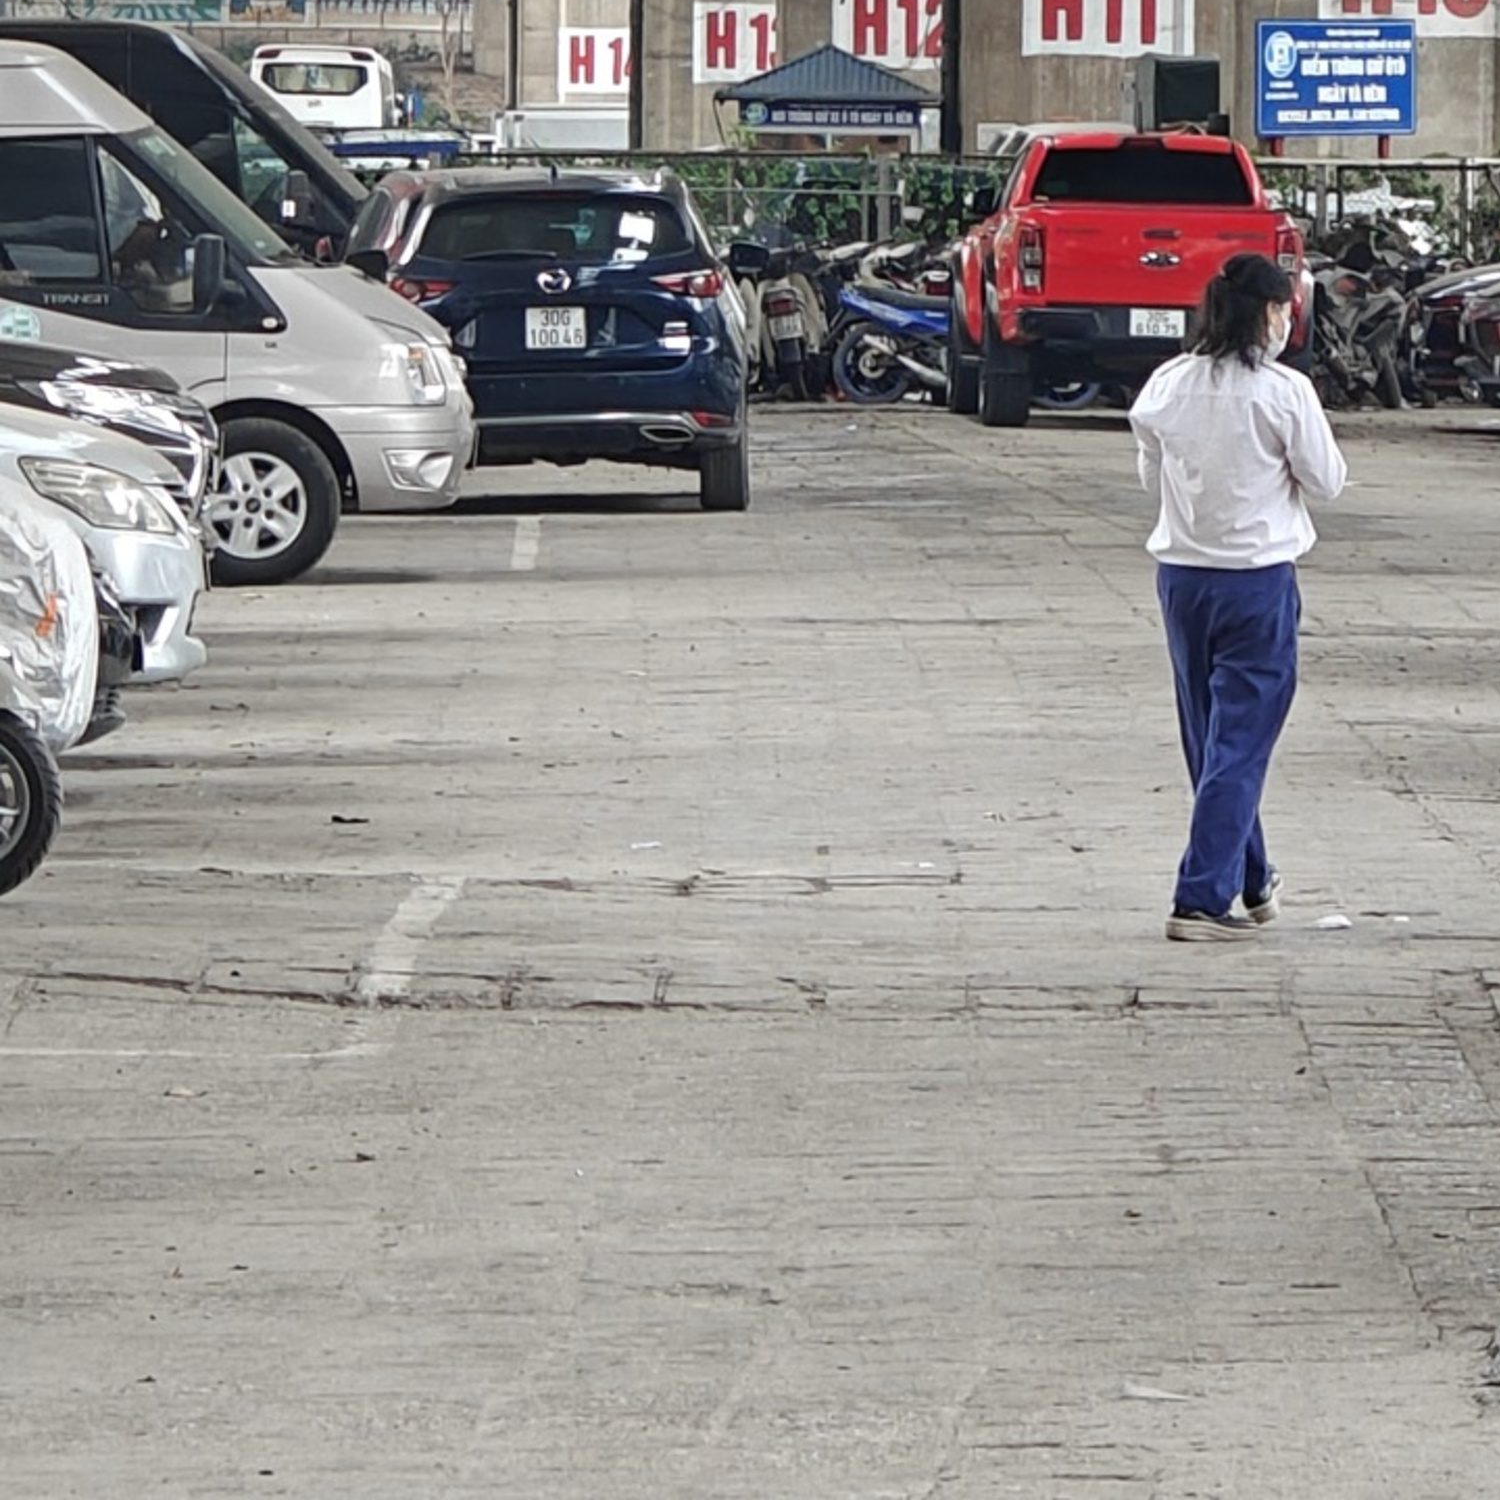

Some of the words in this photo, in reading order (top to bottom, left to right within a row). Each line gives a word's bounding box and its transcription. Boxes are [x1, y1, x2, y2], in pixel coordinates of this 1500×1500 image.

[569, 35, 633, 85] H1
[706, 11, 777, 70] H1
[540, 309, 571, 327] 30G
